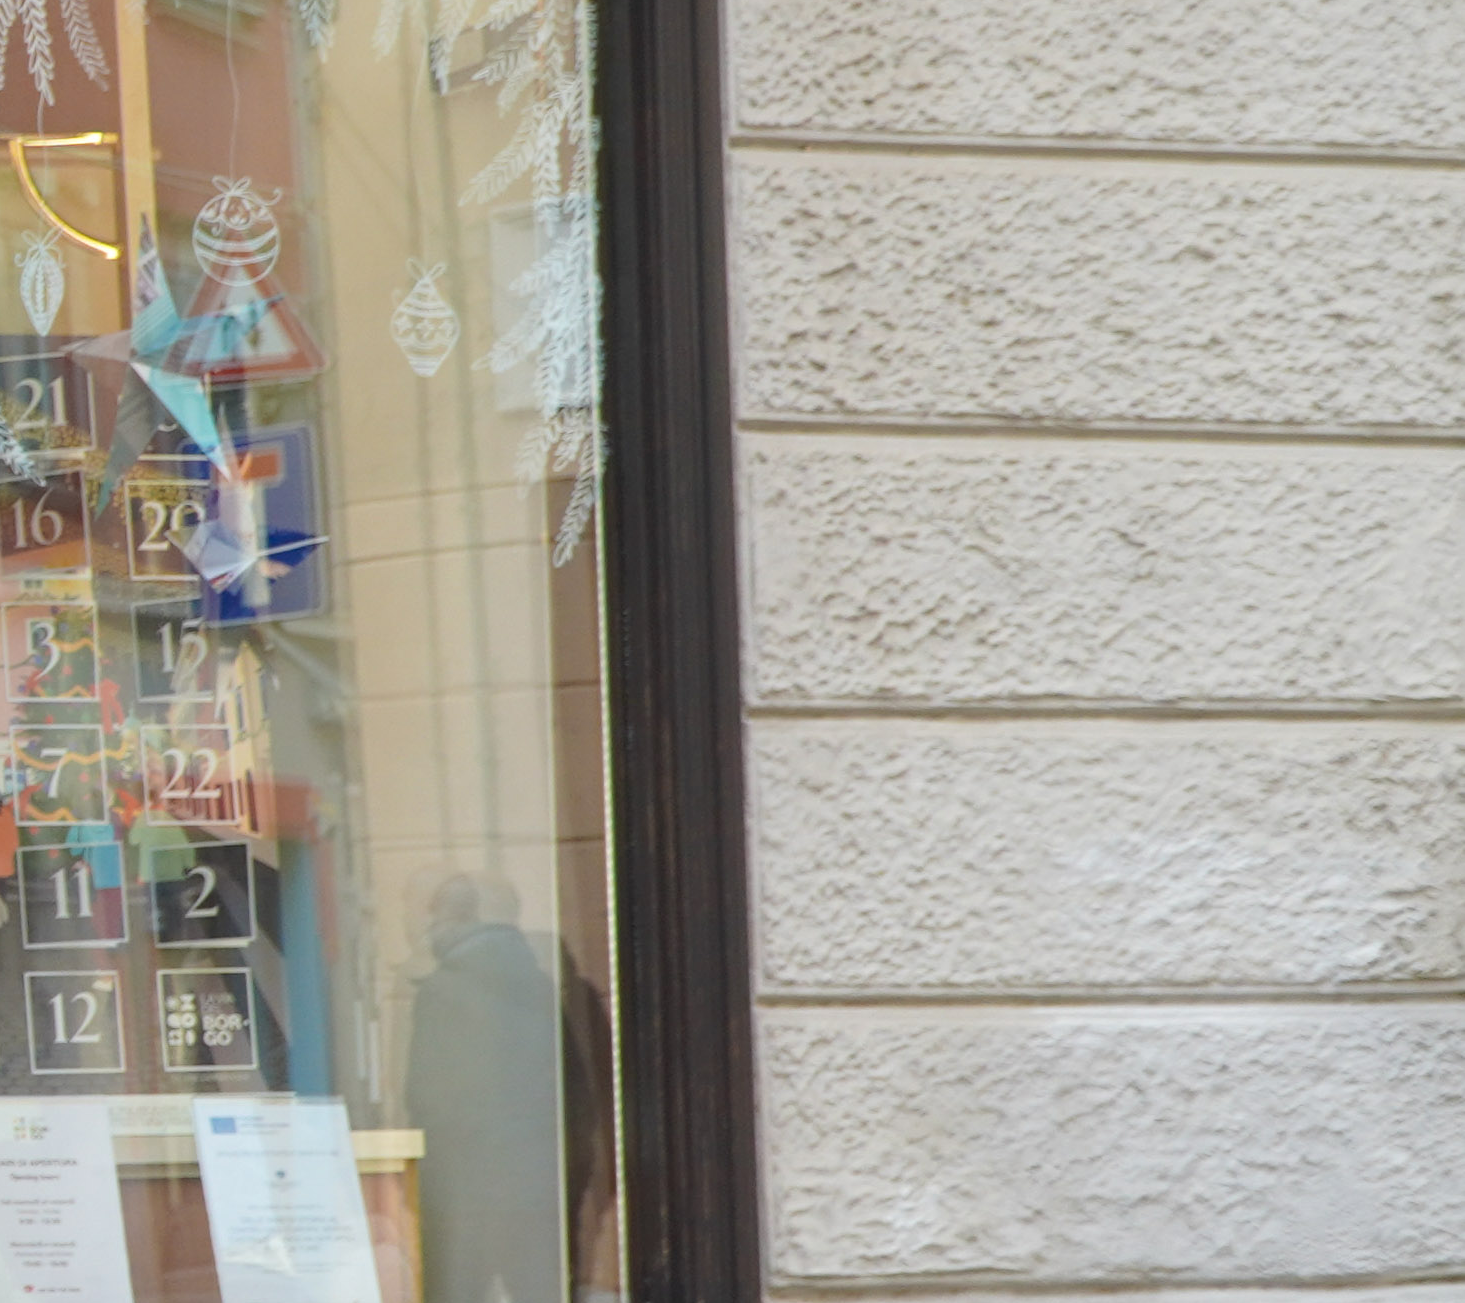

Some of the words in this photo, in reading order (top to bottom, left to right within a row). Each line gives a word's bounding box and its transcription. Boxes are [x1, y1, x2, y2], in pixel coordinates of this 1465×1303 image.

[13, 376, 68, 429] 21
[11, 487, 64, 549] 16
[33, 622, 61, 679] 3
[157, 618, 207, 681] 15
[39, 748, 69, 799] 7
[160, 748, 222, 799] 22
[48, 866, 94, 920] 11
[184, 865, 220, 919] 2
[48, 991, 103, 1044] 12
